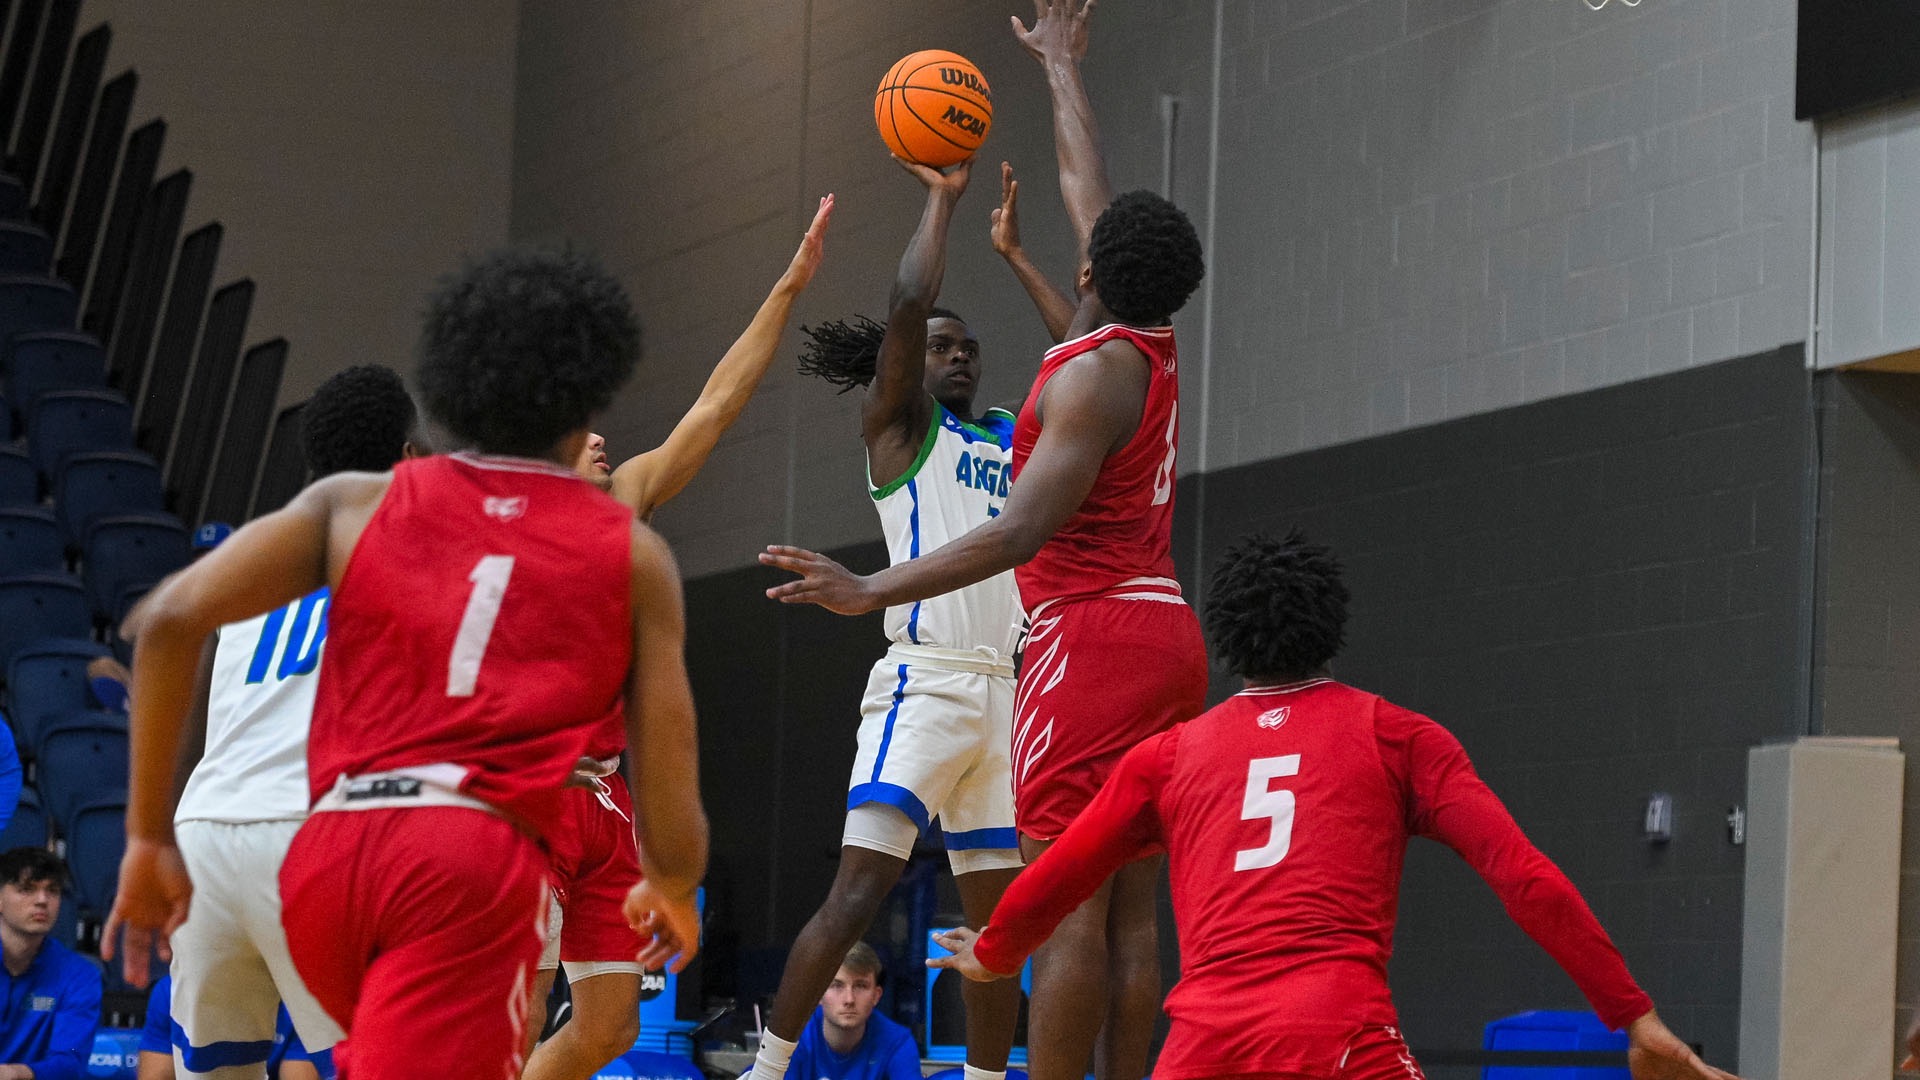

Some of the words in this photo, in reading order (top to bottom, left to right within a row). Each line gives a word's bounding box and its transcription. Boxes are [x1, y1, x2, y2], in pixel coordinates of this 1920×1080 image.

[941, 105, 987, 138] NCAA
[245, 585, 331, 685] 10
[446, 554, 515, 698] 1
[1234, 753, 1302, 872] 5
